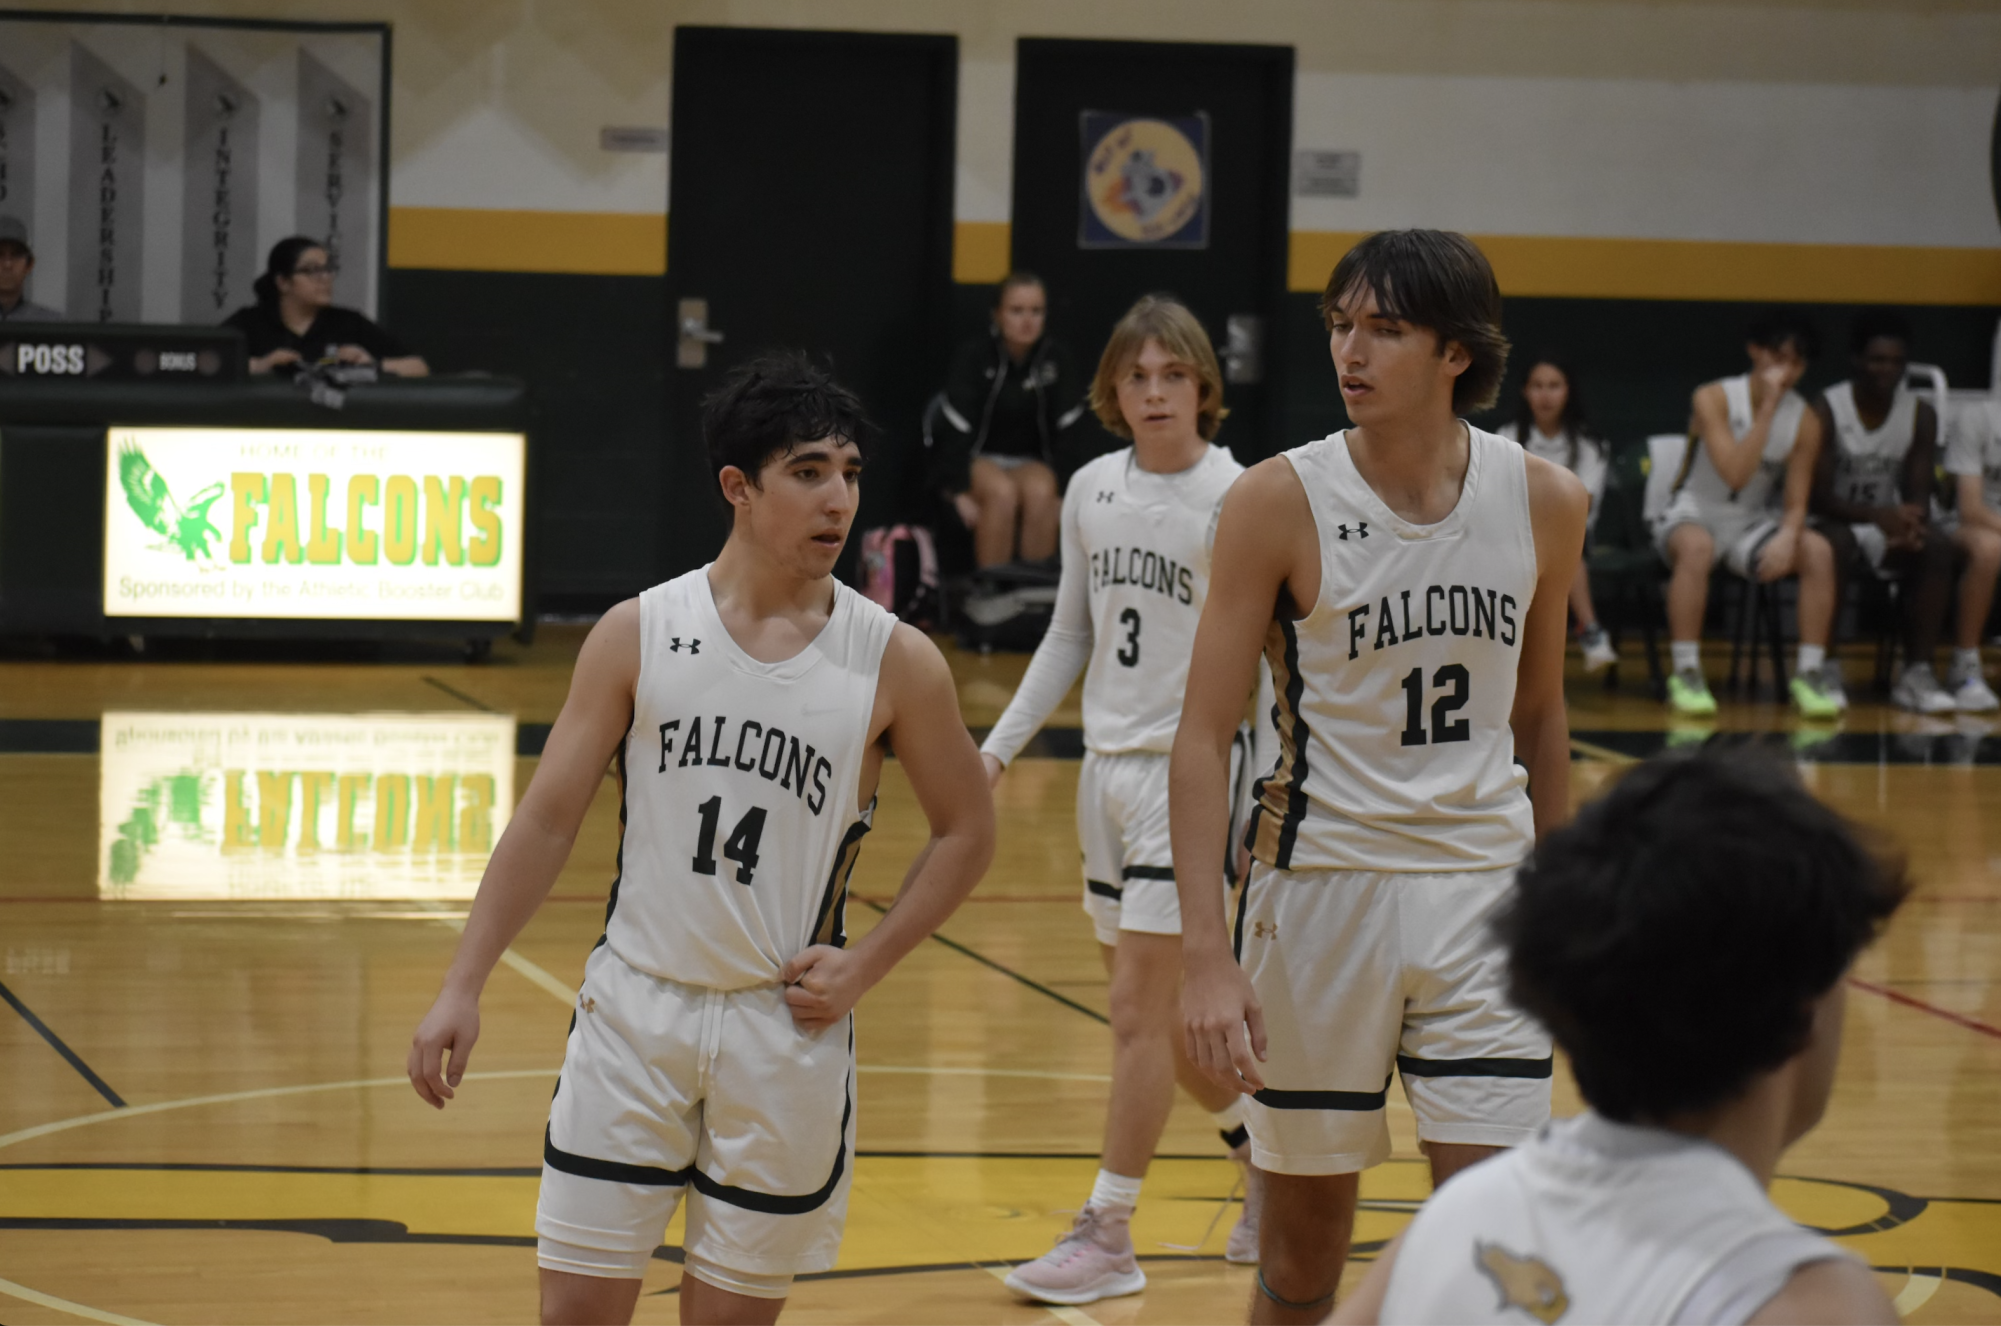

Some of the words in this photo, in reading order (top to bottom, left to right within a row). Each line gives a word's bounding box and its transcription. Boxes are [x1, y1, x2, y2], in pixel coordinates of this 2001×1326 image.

[99, 123, 117, 323] LEADERSHIP
[213, 126, 232, 310] INTEGRITY
[17, 343, 85, 375] POSS
[158, 351, 197, 372] BONUS
[239, 442, 303, 460] HOME
[229, 471, 504, 567] FALCONS
[119, 576, 225, 602] Sponsored
[233, 579, 254, 602] by
[263, 580, 292, 598] the
[299, 580, 369, 599] Athletic
[379, 581, 453, 600] Booster
[460, 581, 505, 601] Club
[1092, 547, 1193, 606] FALCONS
[1117, 607, 1141, 669] 3
[1348, 585, 1516, 661] FALCONS
[1401, 663, 1470, 746] 12
[658, 716, 832, 817] FALCONS
[692, 795, 768, 886] 14
